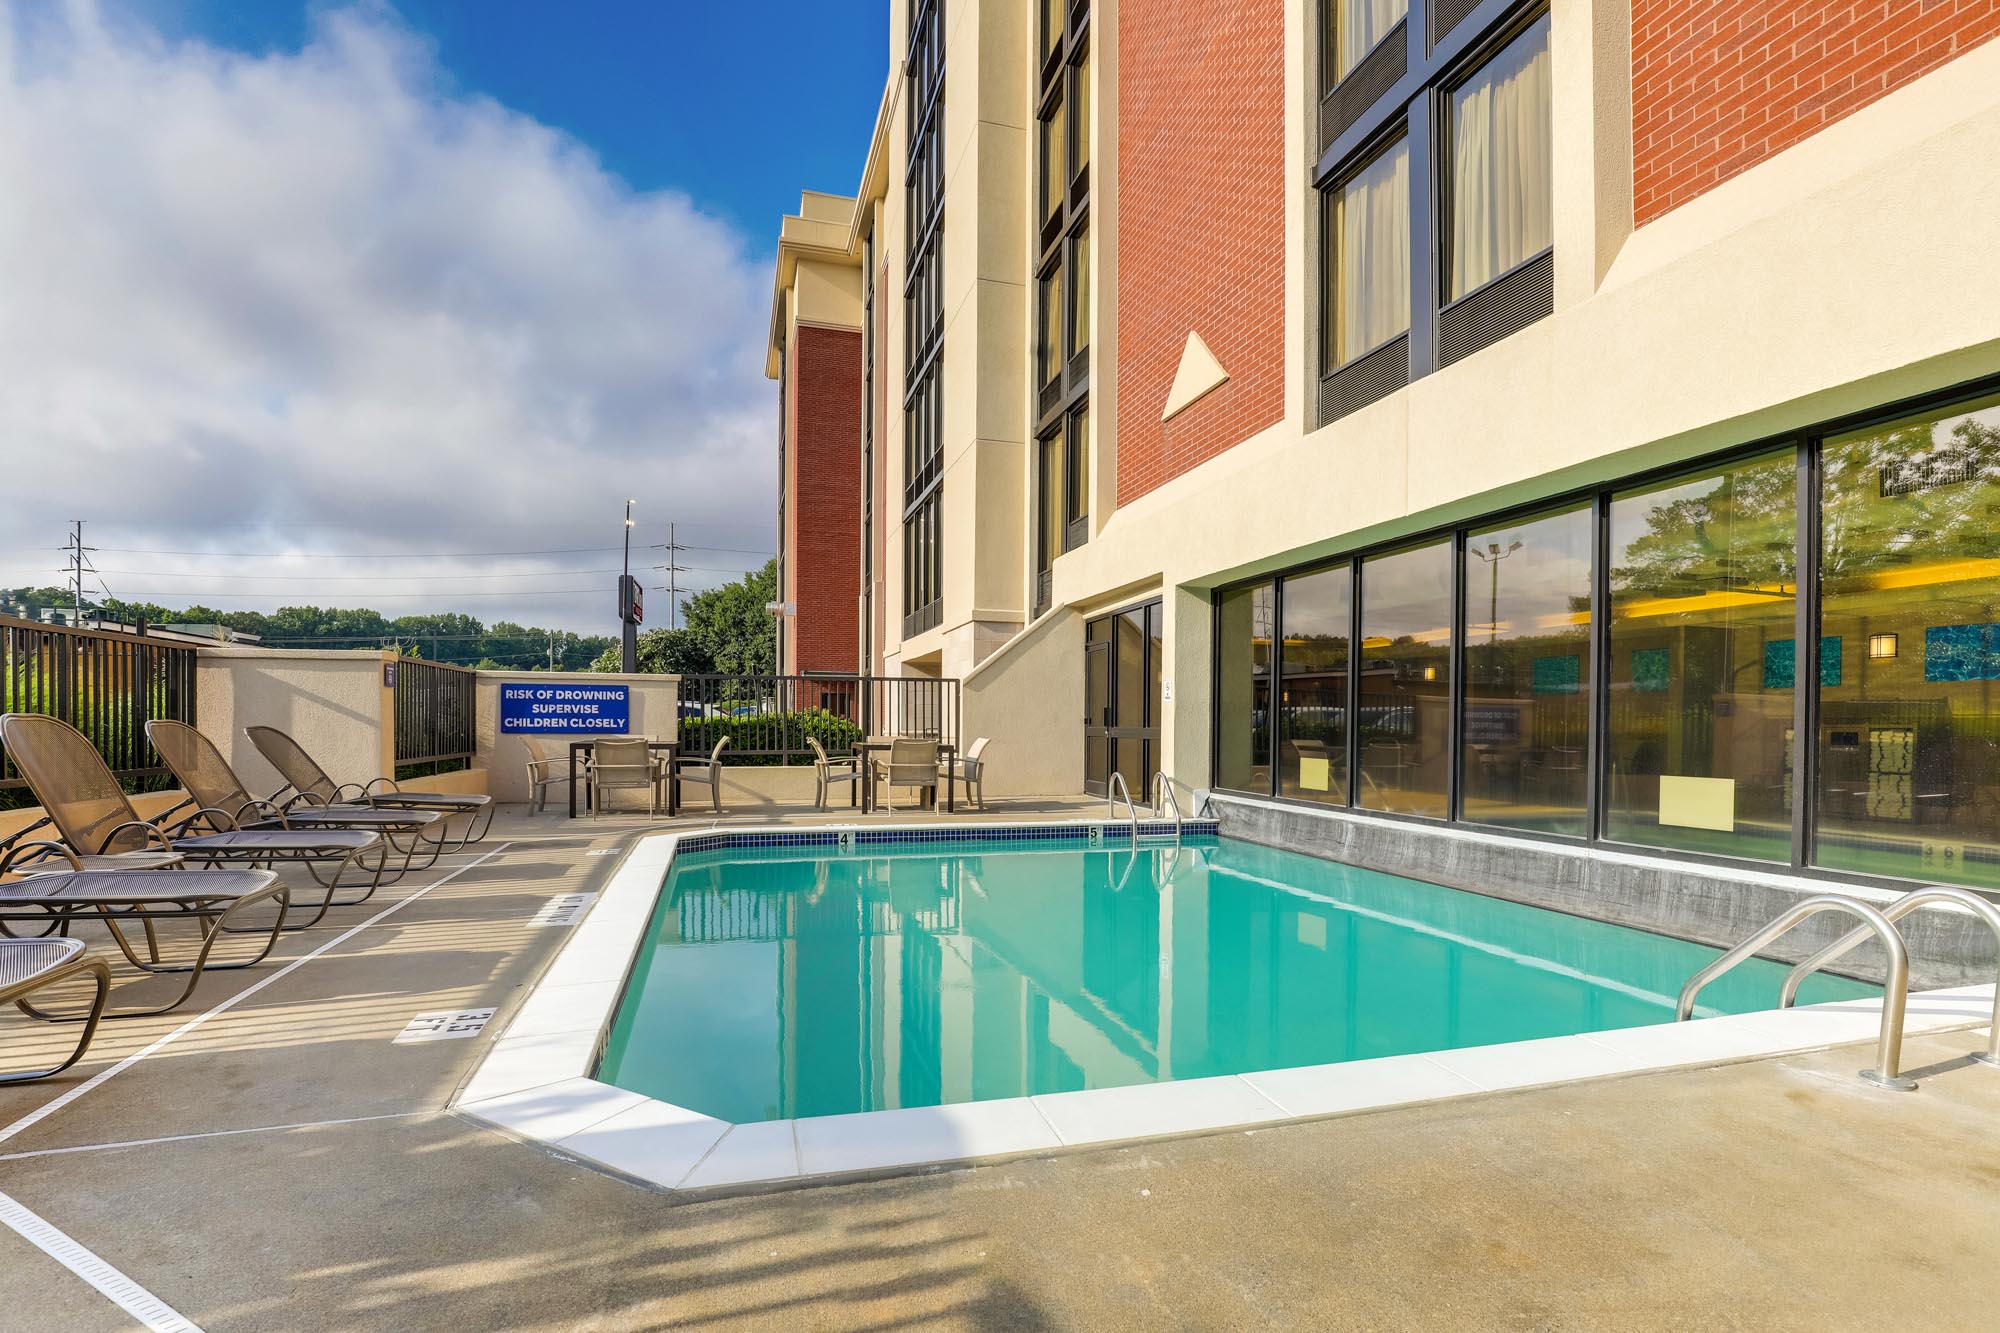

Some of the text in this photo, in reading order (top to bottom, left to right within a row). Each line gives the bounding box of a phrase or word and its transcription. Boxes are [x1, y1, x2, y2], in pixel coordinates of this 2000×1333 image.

[505, 690, 624, 700] RISK OF DROWNING
[532, 704, 599, 714] SUPERVISE
[504, 717, 626, 728] CHILDREN CLOSELY
[1090, 827, 1097, 838] 5
[840, 833, 848, 845] 4
[405, 1016, 448, 1032] FT
[446, 1013, 492, 1033] 3.5
